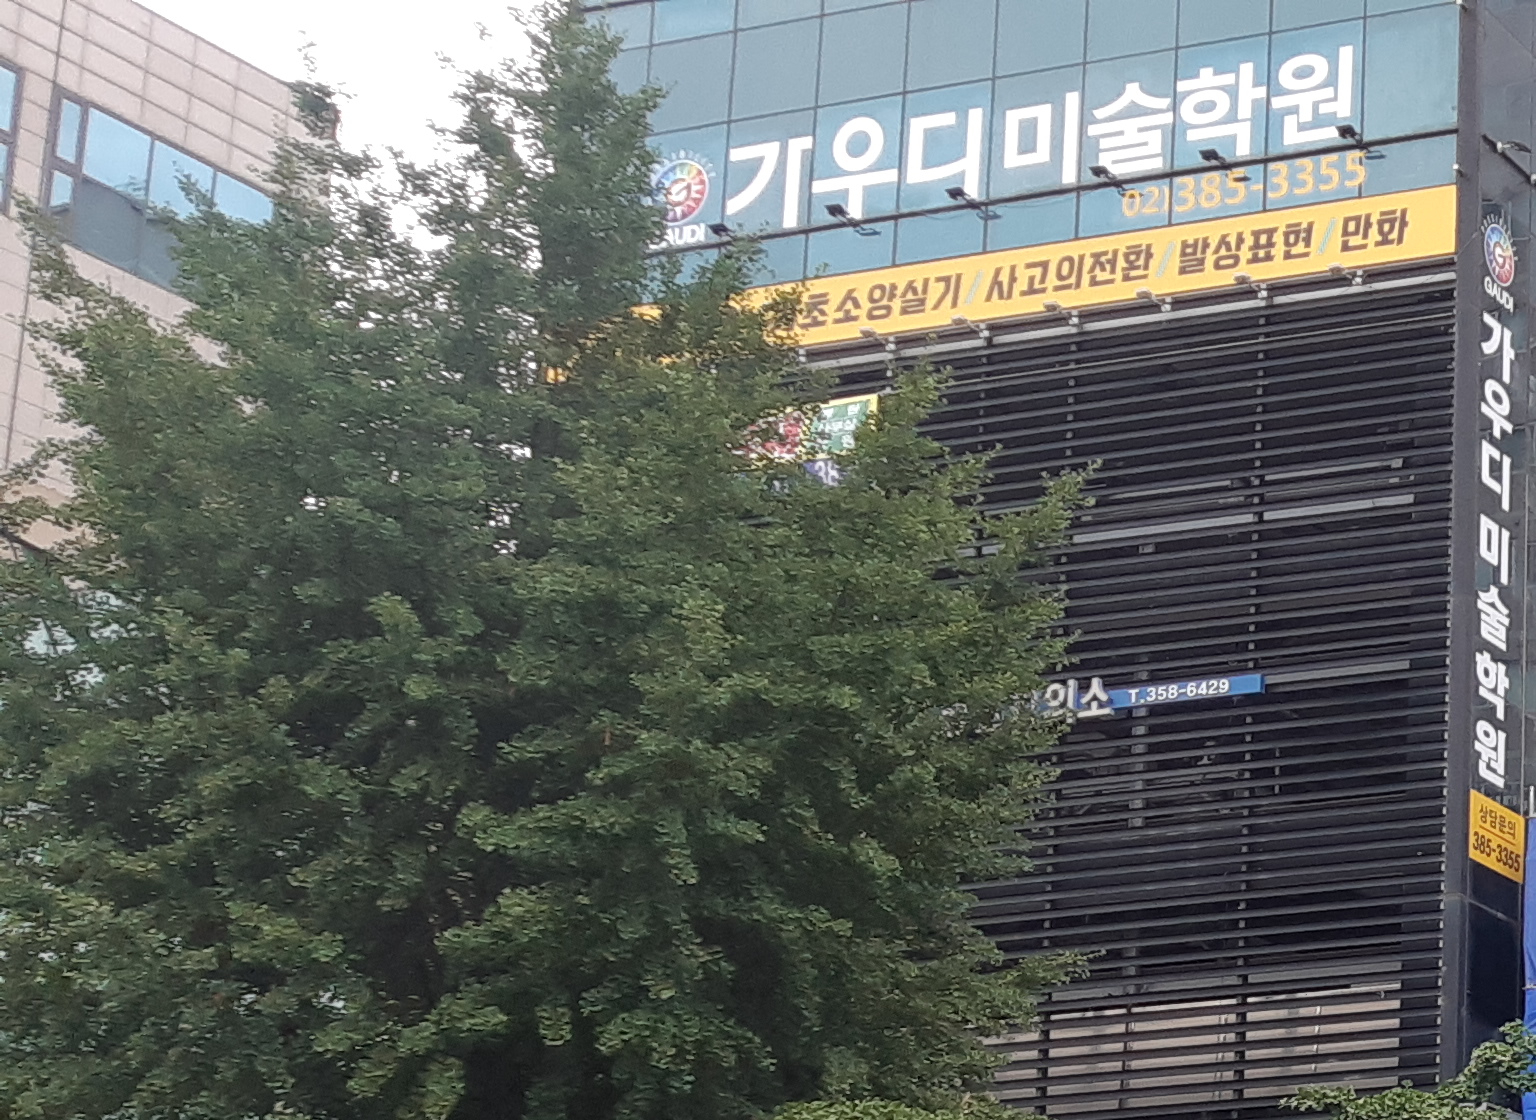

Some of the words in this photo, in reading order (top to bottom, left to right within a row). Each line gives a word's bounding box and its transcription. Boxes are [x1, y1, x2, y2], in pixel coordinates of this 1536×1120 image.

[725, 44, 1354, 231] 가우디미술학원
[1121, 150, 1369, 218] 02)385-3355
[648, 222, 706, 249] AUDI
[798, 272, 964, 330] 초소양실기
[985, 243, 1155, 302] 사고의전환
[1177, 220, 1315, 276] 발상표현
[1339, 207, 1409, 253] 만화
[1474, 311, 1516, 789] 가우디미술학원
[1127, 679, 1230, 704] T.358-6429
[1479, 803, 1516, 841] 상담문의
[1472, 830, 1521, 873] 385-3355
